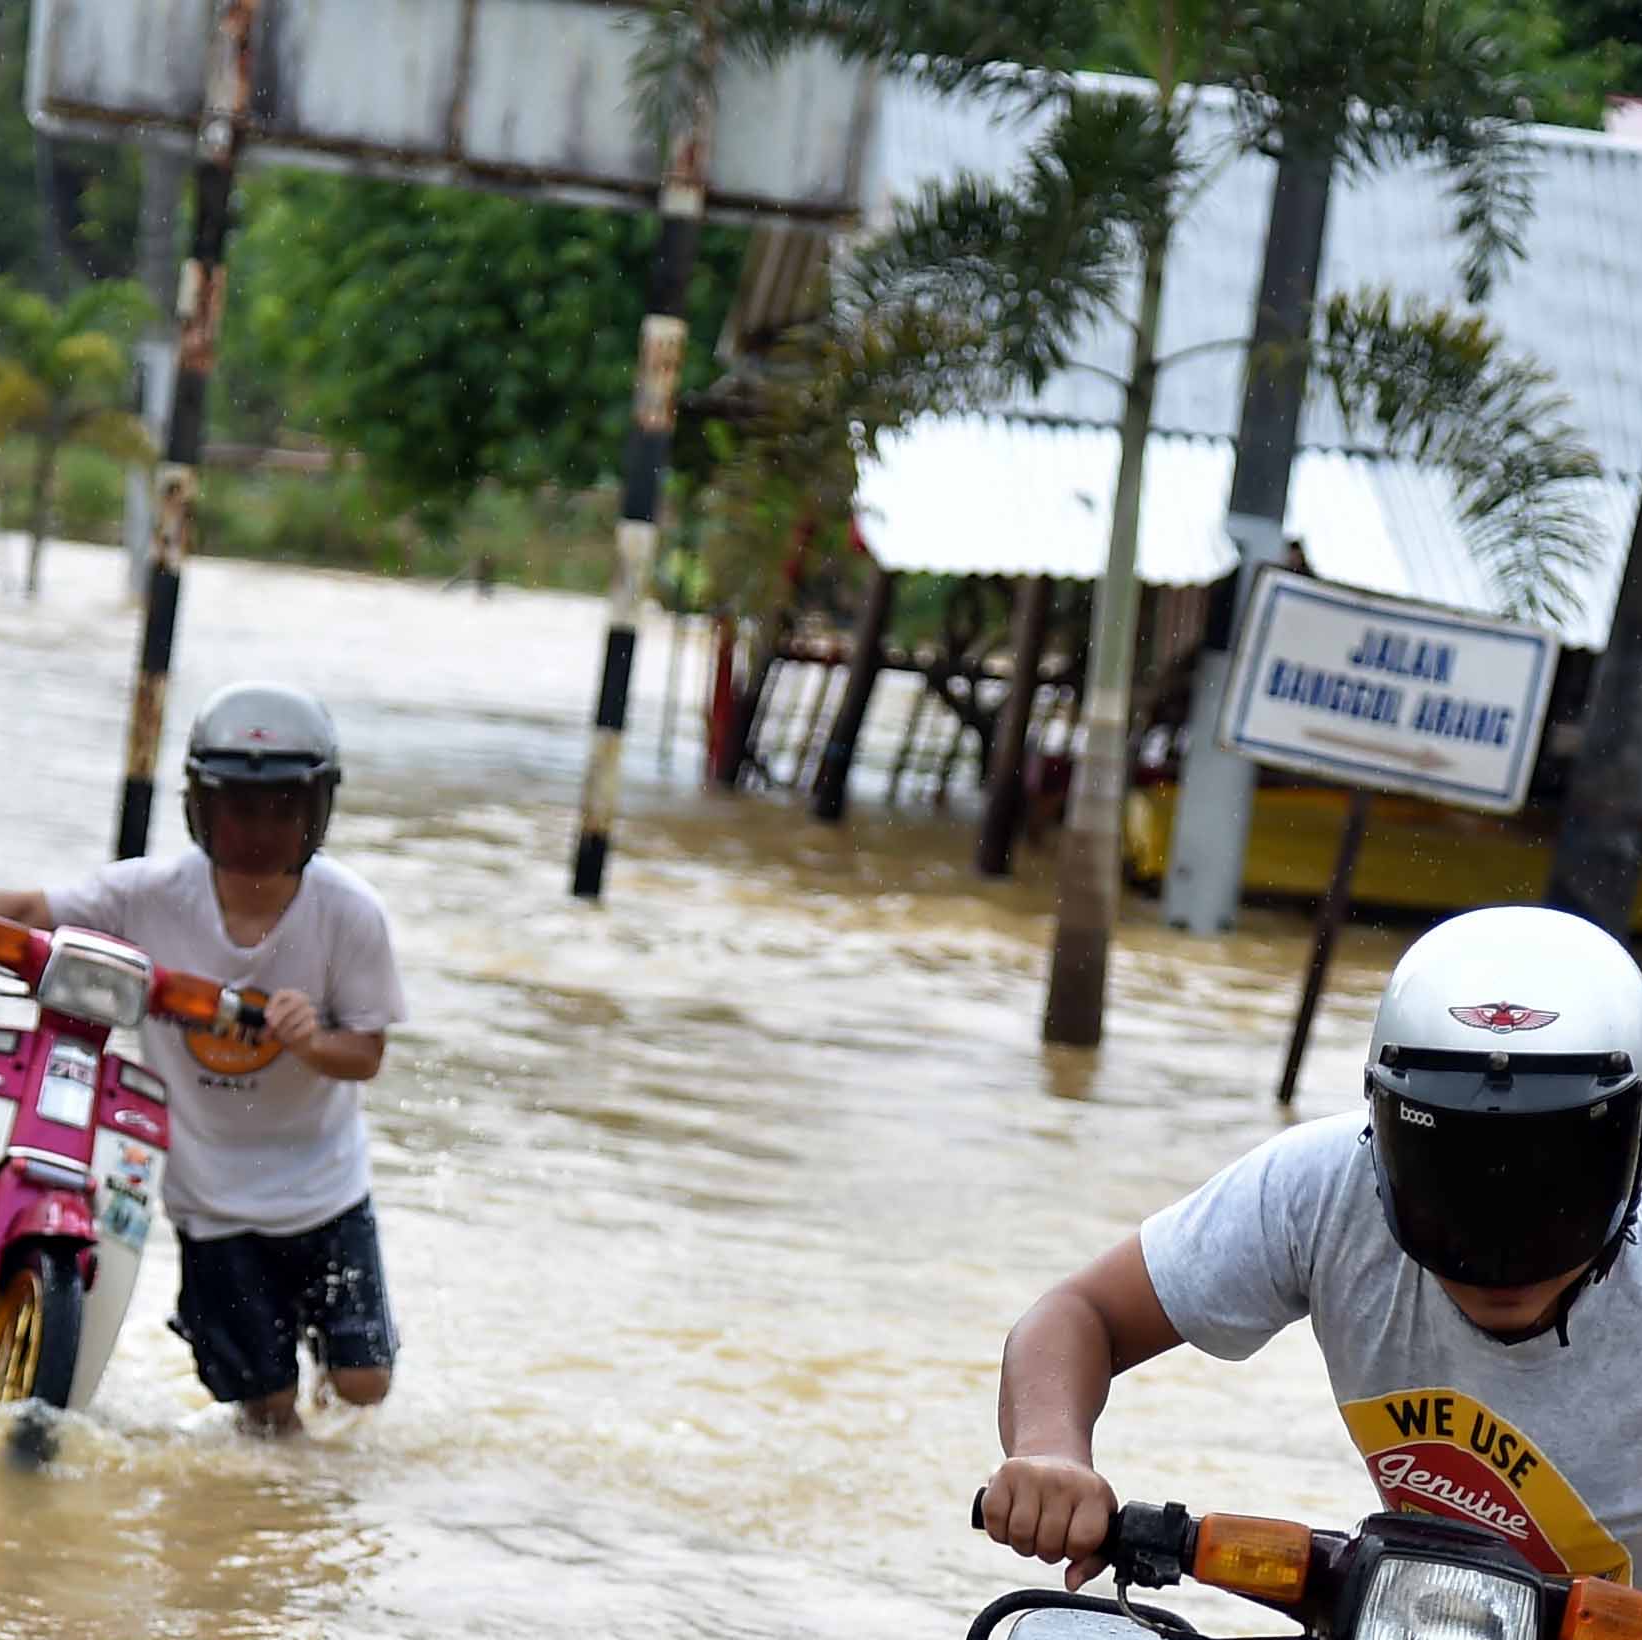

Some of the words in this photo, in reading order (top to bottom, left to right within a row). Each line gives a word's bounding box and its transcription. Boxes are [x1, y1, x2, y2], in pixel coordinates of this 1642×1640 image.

[1348, 629, 1457, 684] JALAN
[1267, 657, 1406, 728] BANGGOL
[1412, 687, 1515, 748] ARANG
[1385, 1398, 1454, 1437] WE
[1470, 1410, 1538, 1489] USE
[1377, 1453, 1530, 1539] Genuine
